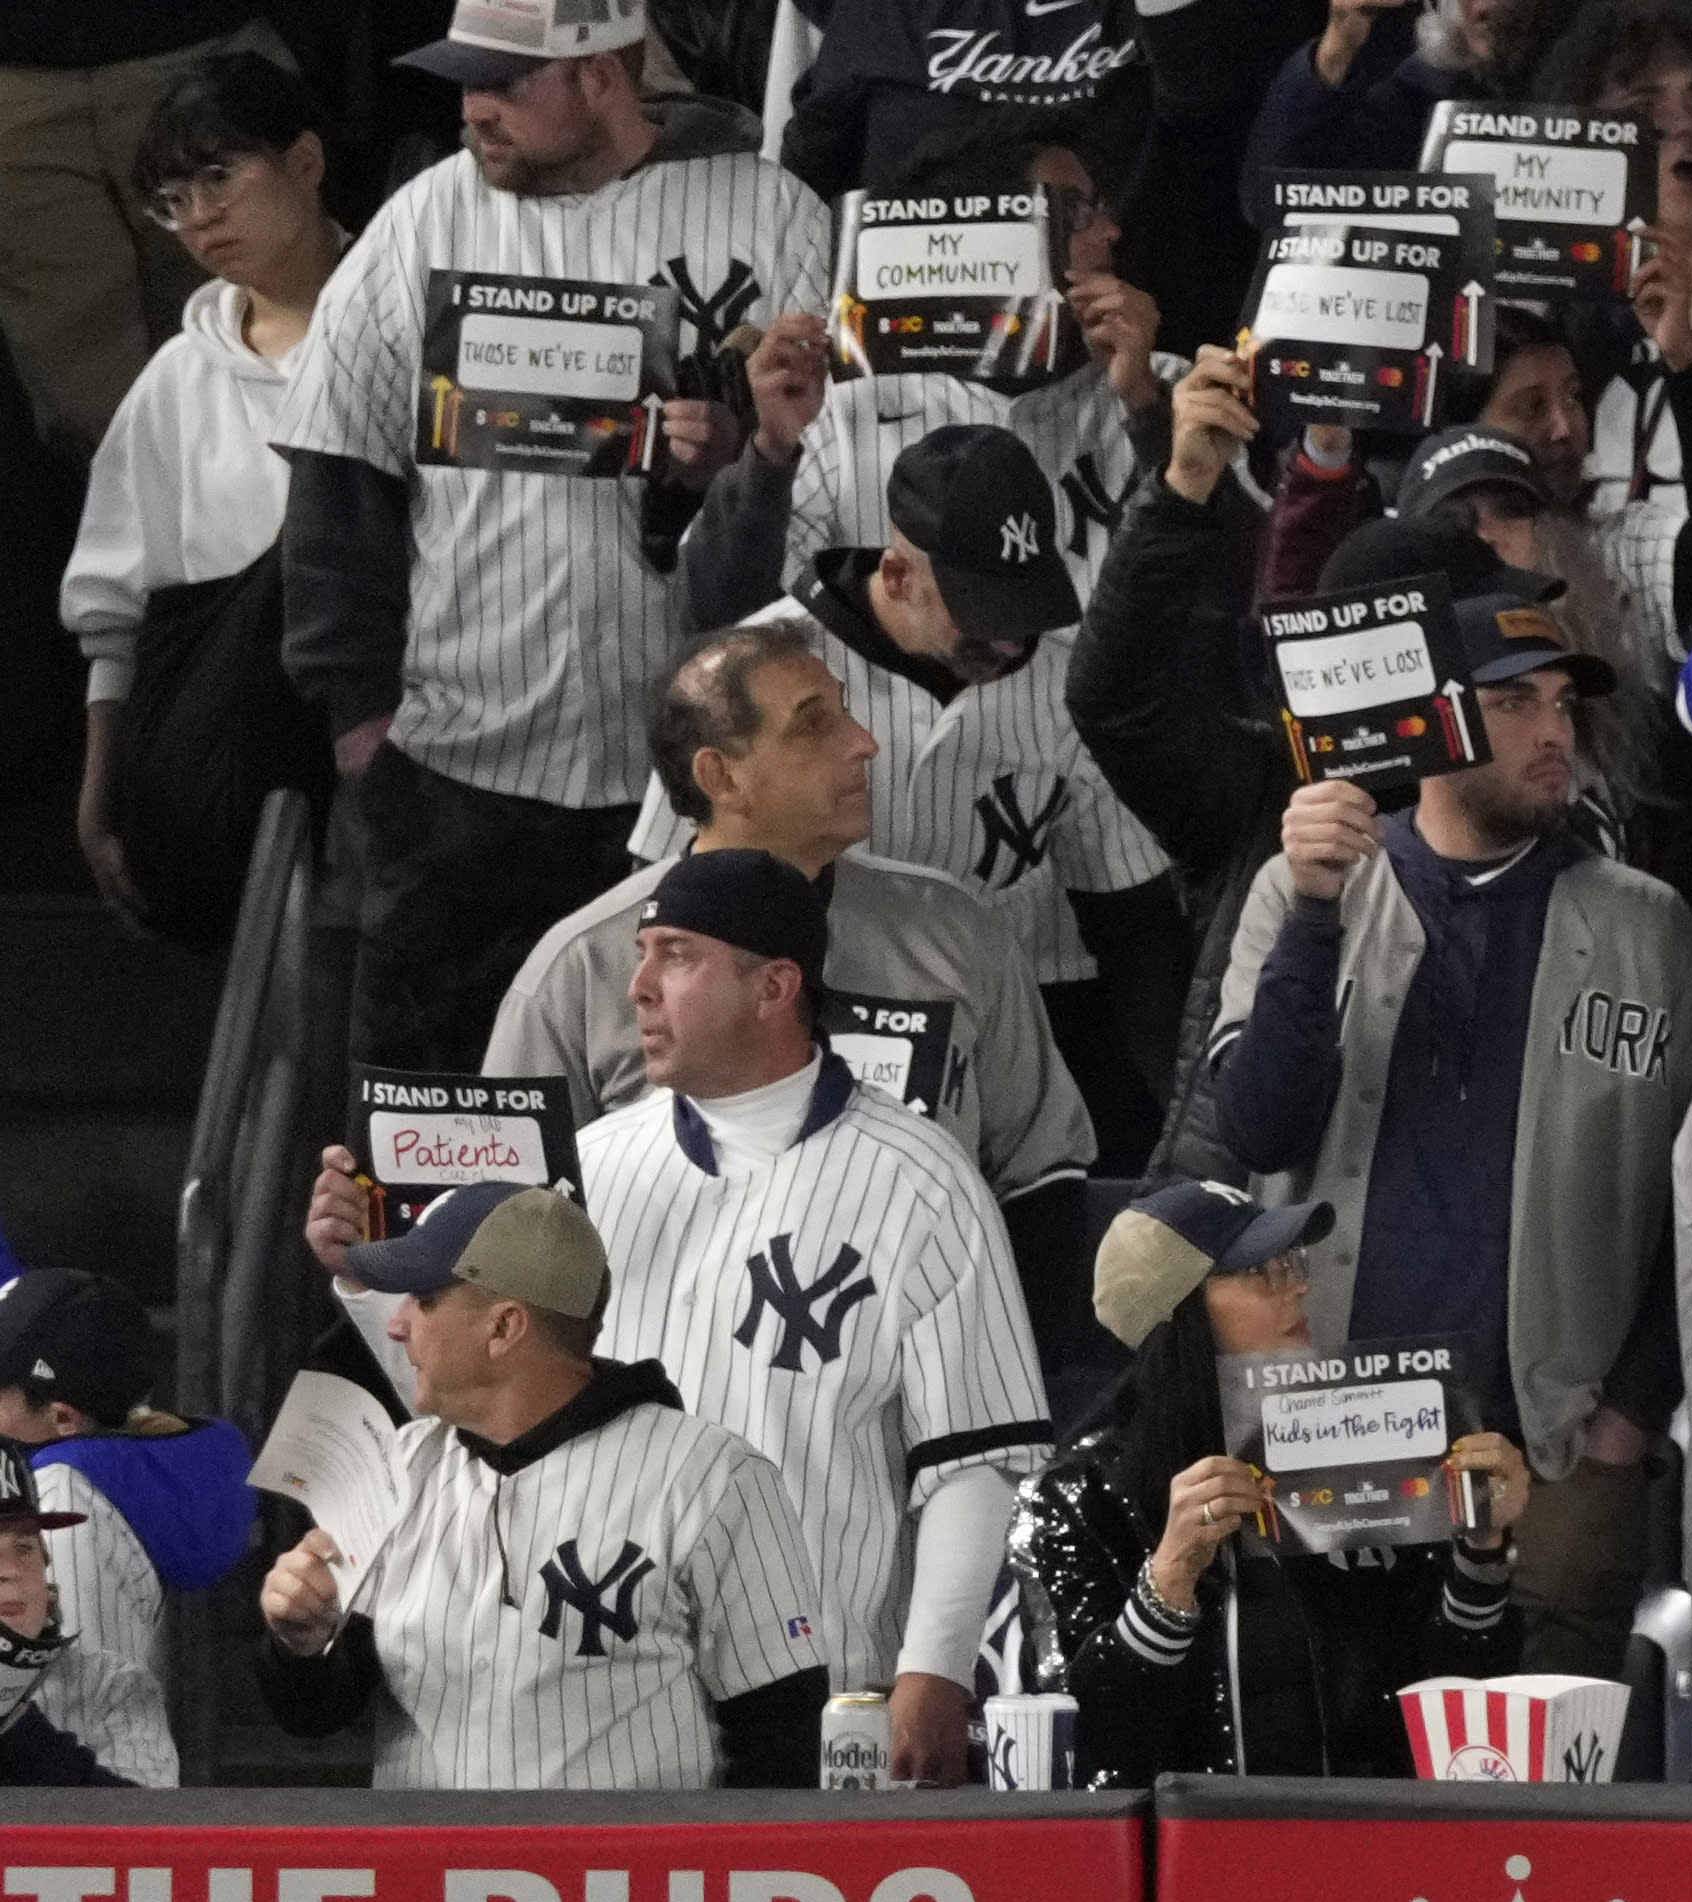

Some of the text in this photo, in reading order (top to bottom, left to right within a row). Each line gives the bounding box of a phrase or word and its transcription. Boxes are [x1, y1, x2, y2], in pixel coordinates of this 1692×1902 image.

[862, 194, 1047, 222] STAND UP FOR
[927, 232, 963, 256] MY
[875, 260, 1019, 290] COMMUNITY
[451, 283, 654, 319] I STAND UP FOR
[361, 1079, 546, 1110] I STAND UP FOR
[392, 1128, 520, 1169] Patients
[1246, 1348, 1451, 1388] I STAND UP FOR
[1266, 1406, 1442, 1447] Kids in the Fight
[822, 1739, 888, 1770] Modelo
